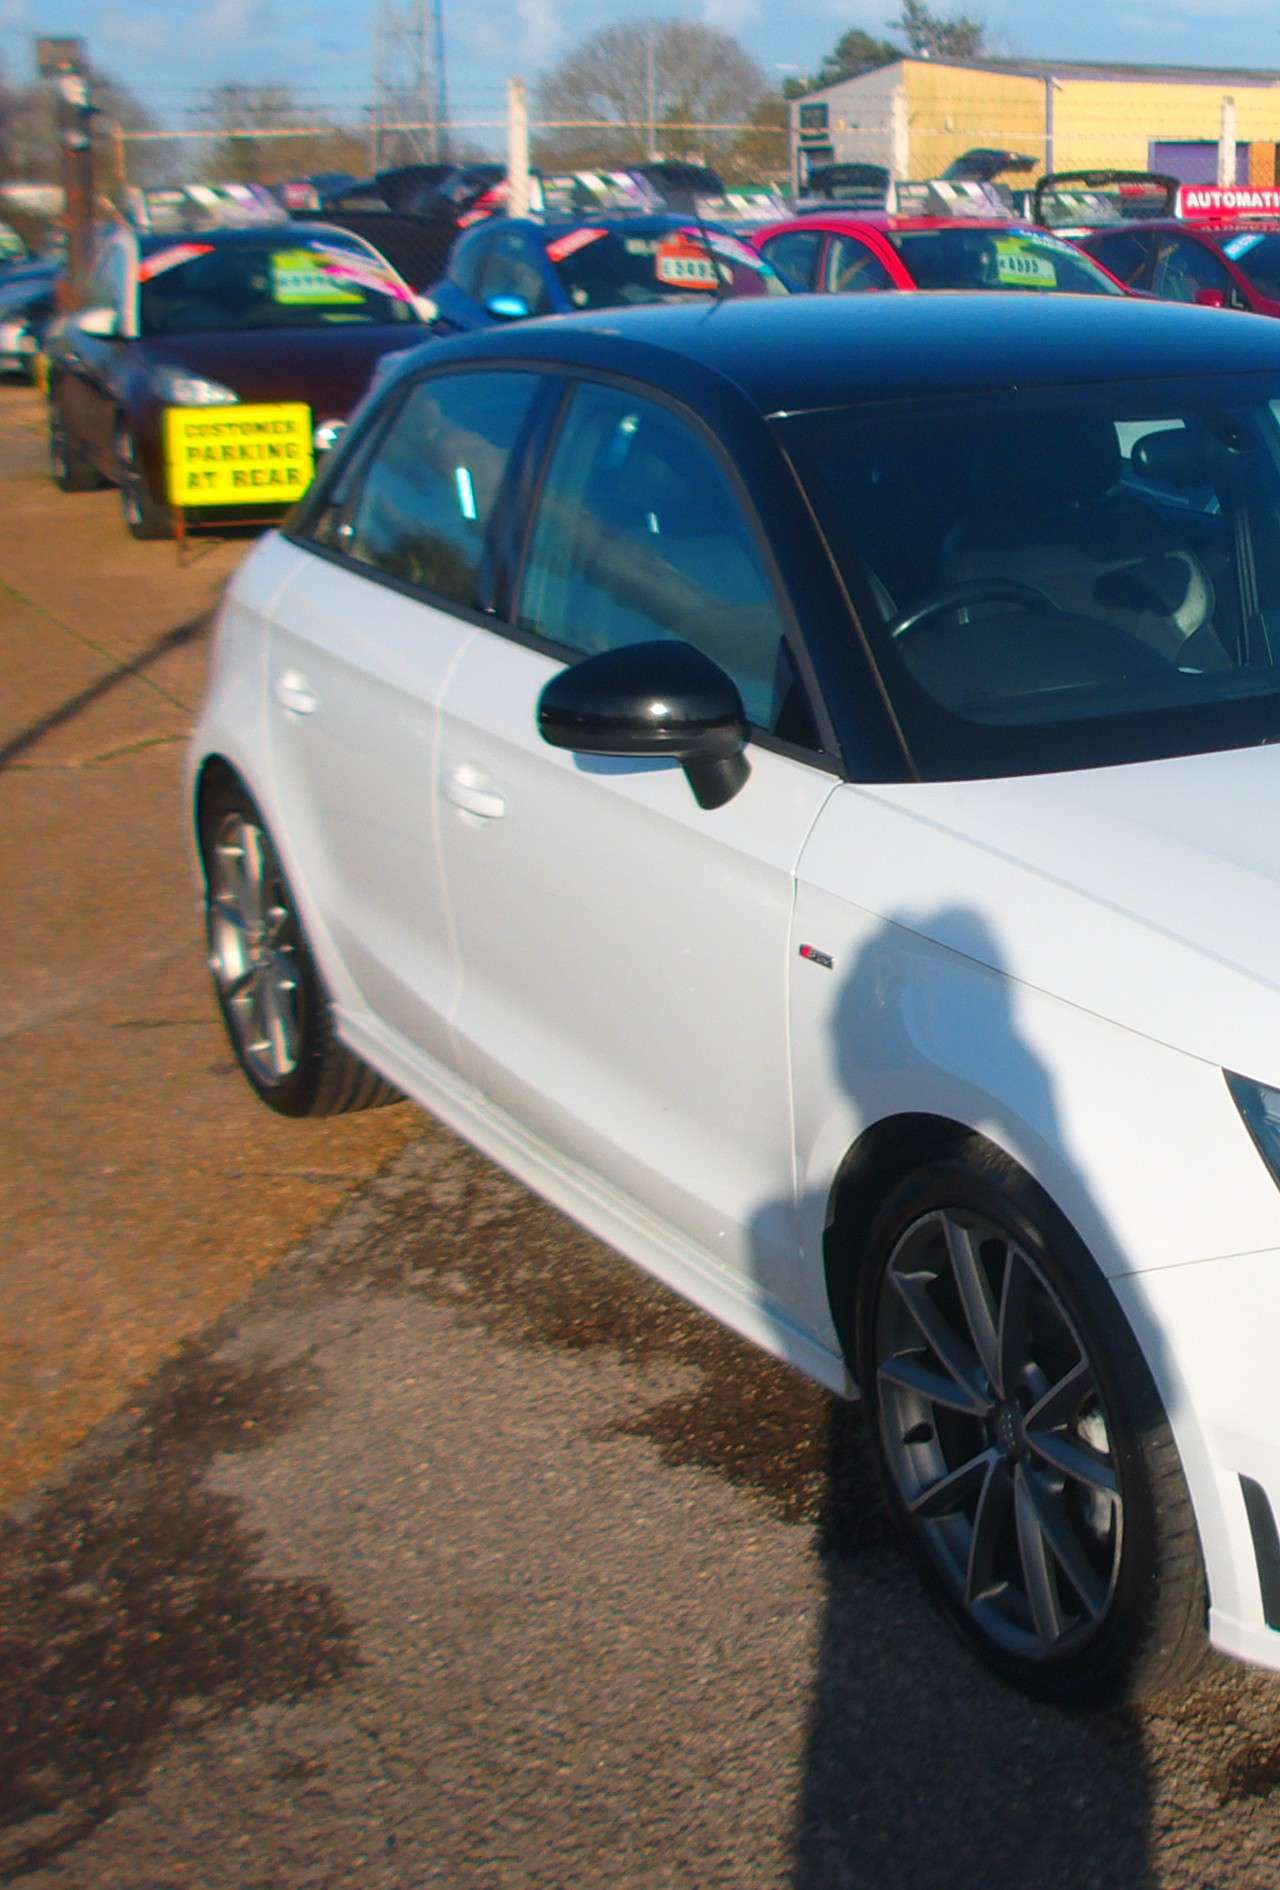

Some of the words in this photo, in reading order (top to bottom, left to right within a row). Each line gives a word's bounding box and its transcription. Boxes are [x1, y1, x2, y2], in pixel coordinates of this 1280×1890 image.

[184, 420, 298, 438] CUSTOMER
[185, 443, 300, 464] PARKING
[187, 471, 217, 489] AT
[231, 467, 301, 488] REAR
